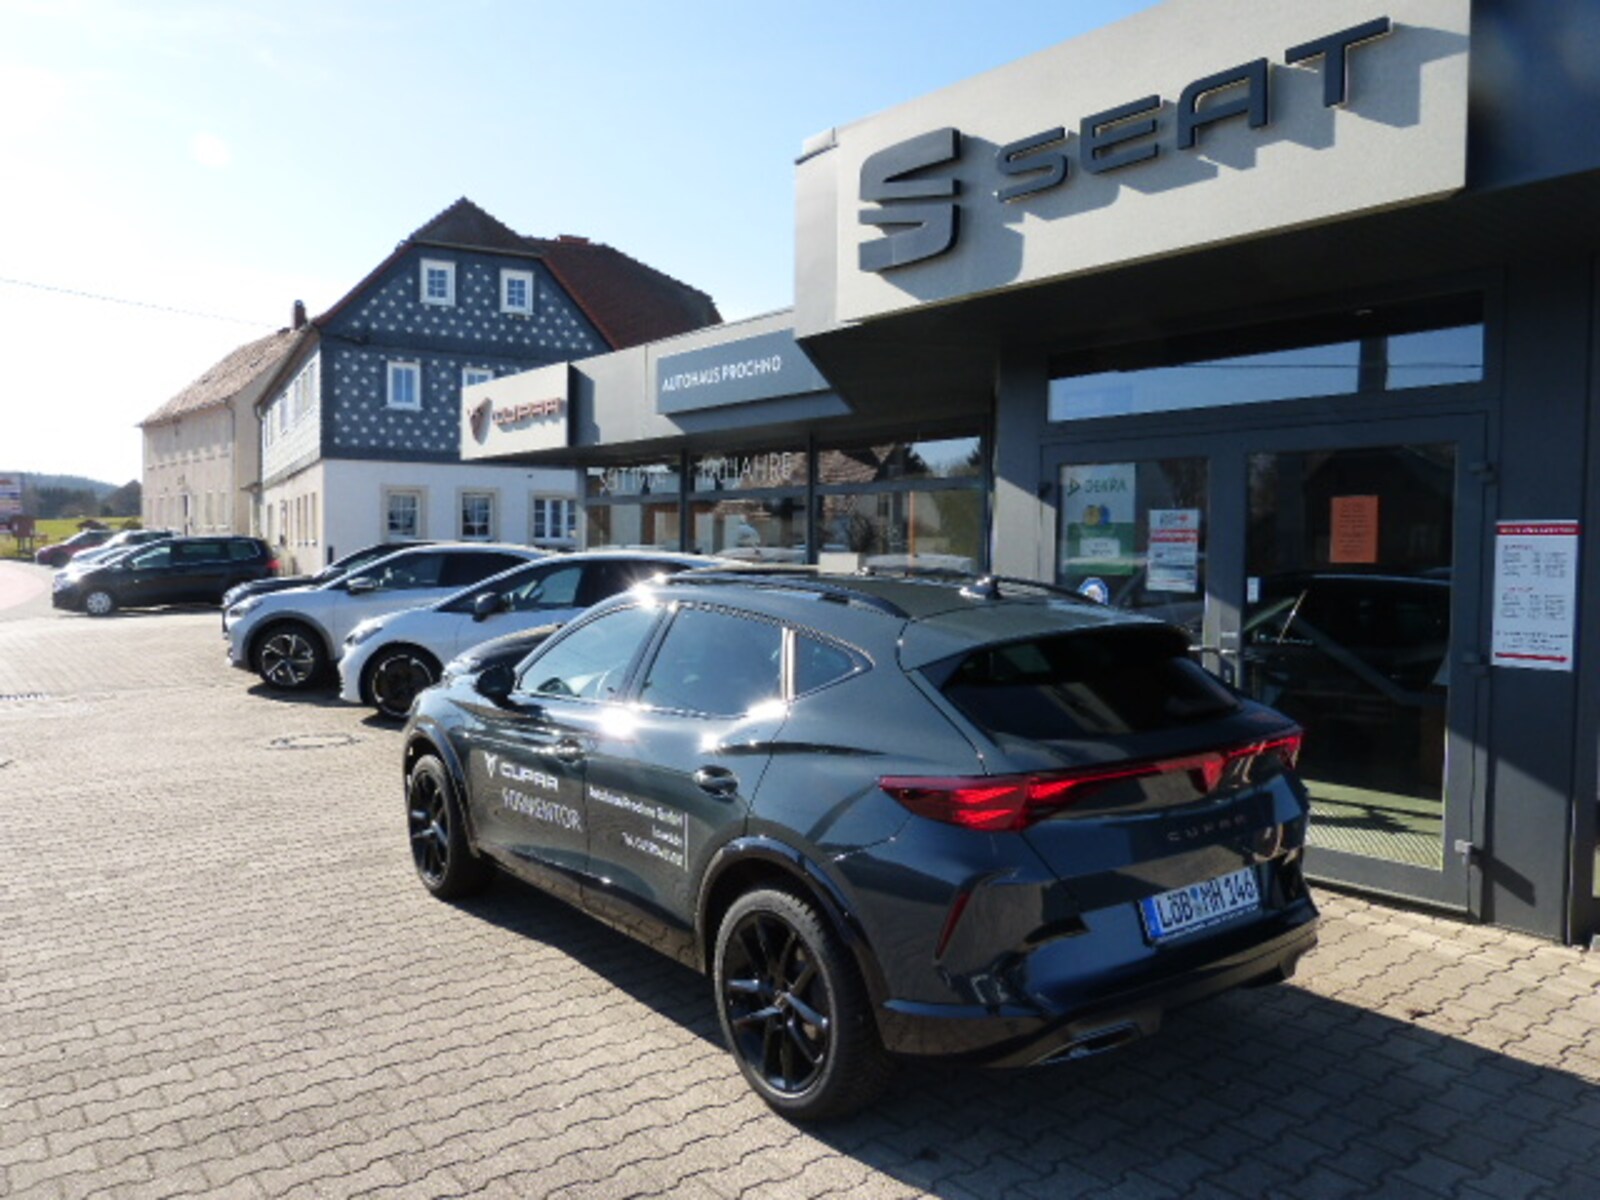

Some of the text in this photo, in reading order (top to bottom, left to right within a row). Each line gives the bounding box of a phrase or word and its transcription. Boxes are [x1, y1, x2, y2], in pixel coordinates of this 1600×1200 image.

[997, 16, 1393, 203] SEAT
[661, 354, 782, 392] AUTOHAUS PROCHNO
[492, 397, 563, 426] CUPRA
[501, 763, 559, 791] CUPRA
